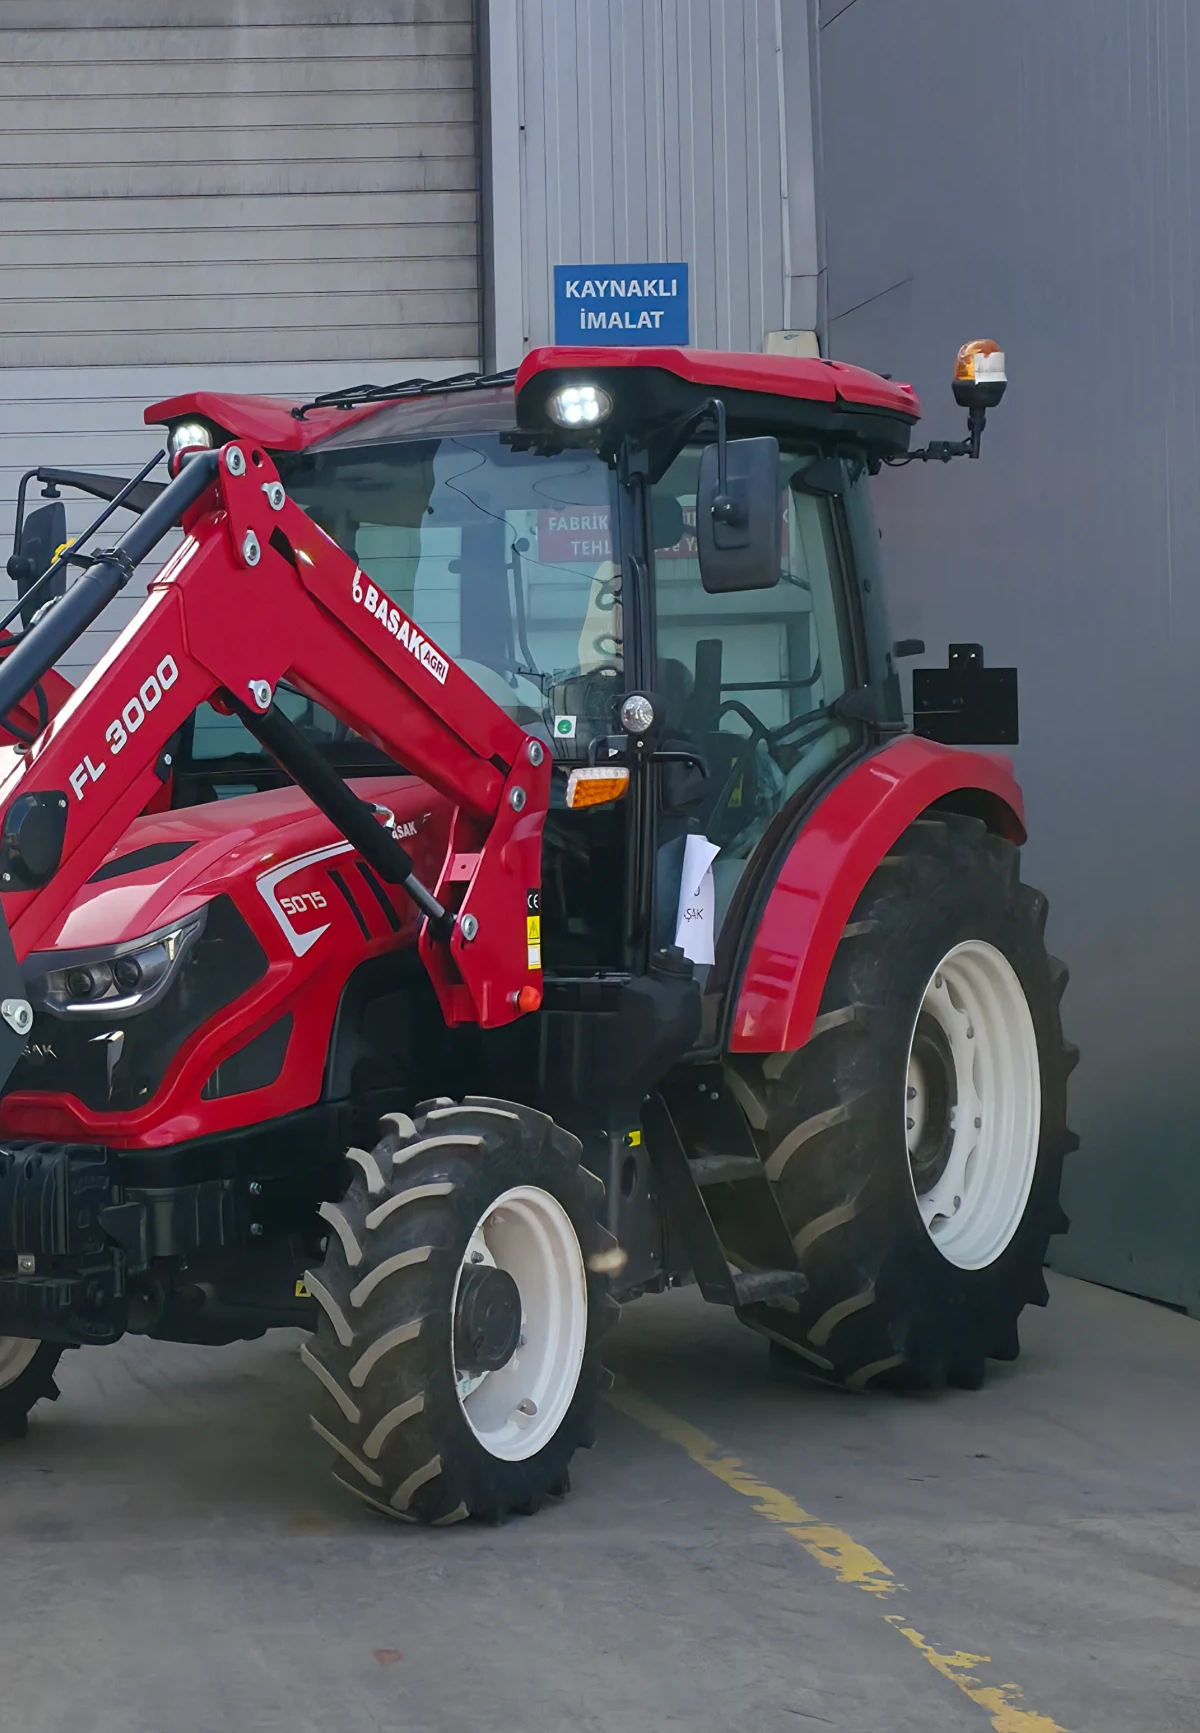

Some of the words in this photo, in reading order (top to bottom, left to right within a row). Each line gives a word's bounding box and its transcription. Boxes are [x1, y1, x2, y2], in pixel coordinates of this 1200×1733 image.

[565, 279, 677, 298] KAYNAKLI
[580, 308, 664, 329] İMALAT
[548, 512, 609, 531] FABRİK
[570, 540, 612, 556] TEHL
[364, 584, 424, 661] BASAK
[423, 650, 446, 679] AGRI
[68, 755, 106, 801] FL
[105, 654, 179, 755] 3000
[391, 821, 418, 839] ASAK
[280, 891, 328, 915] 5075
[527, 893, 540, 909] CE
